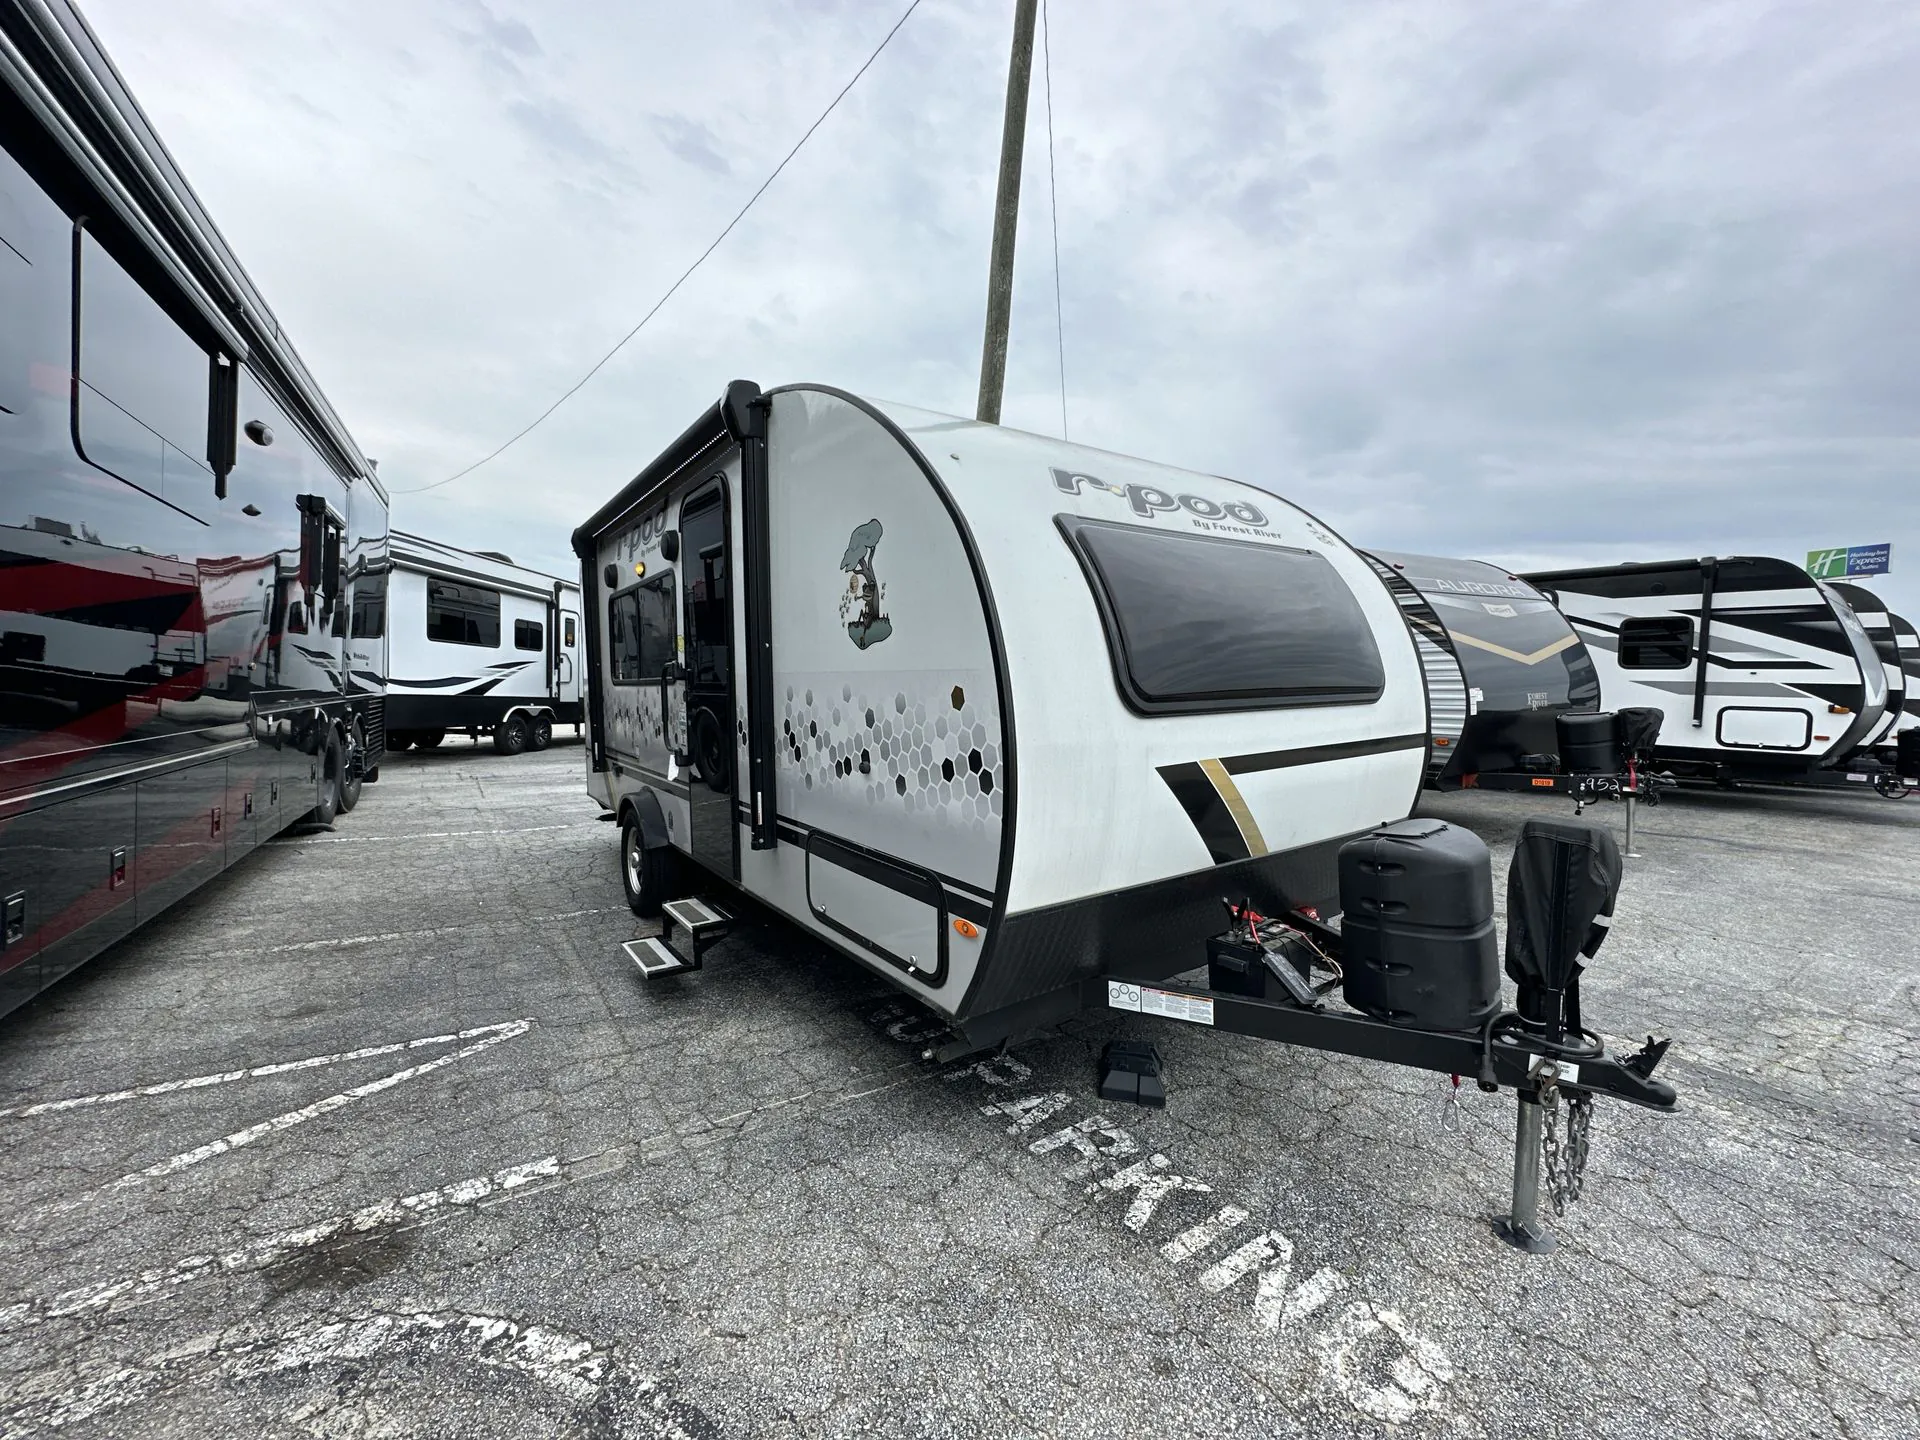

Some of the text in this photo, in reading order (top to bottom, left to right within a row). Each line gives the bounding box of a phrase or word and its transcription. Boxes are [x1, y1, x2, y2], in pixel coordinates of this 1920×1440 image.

[1193, 519, 1283, 540] By Forest River
[1849, 556, 1887, 566] Express
[1436, 579, 1526, 597] AURORA
[1527, 692, 1548, 706] FOREST
[1532, 700, 1548, 711] RIVER
[1586, 778, 1620, 793] 952
[943, 1054, 1455, 1423] PARKING
